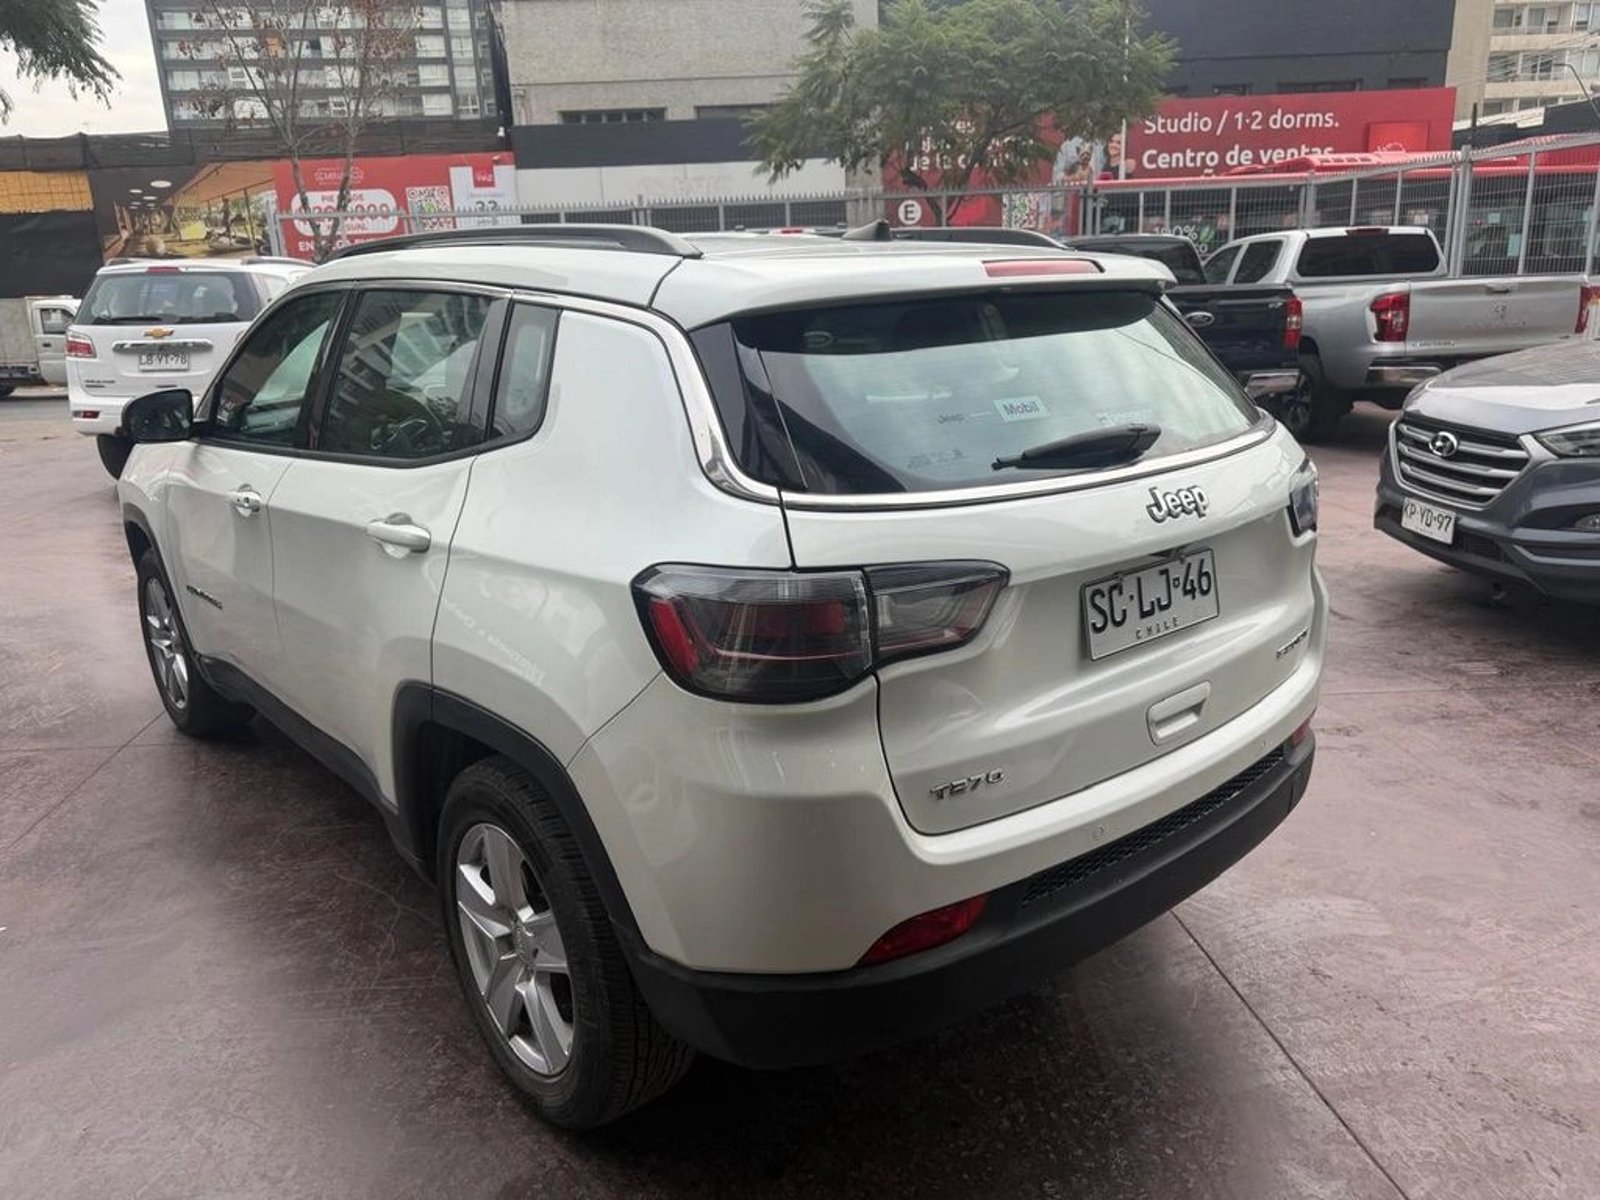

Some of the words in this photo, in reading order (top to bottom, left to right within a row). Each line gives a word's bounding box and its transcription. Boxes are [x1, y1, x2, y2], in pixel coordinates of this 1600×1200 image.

[1144, 111, 1212, 134] Studio
[1216, 110, 1228, 135] /
[1269, 108, 1339, 129] dorms.
[1142, 147, 1218, 169] Centro
[1226, 144, 1252, 166] de
[903, 203, 915, 221] E
[1002, 401, 1040, 416] Mobil
[1146, 485, 1209, 523] Jeep
[1135, 617, 1179, 640] CHILE
